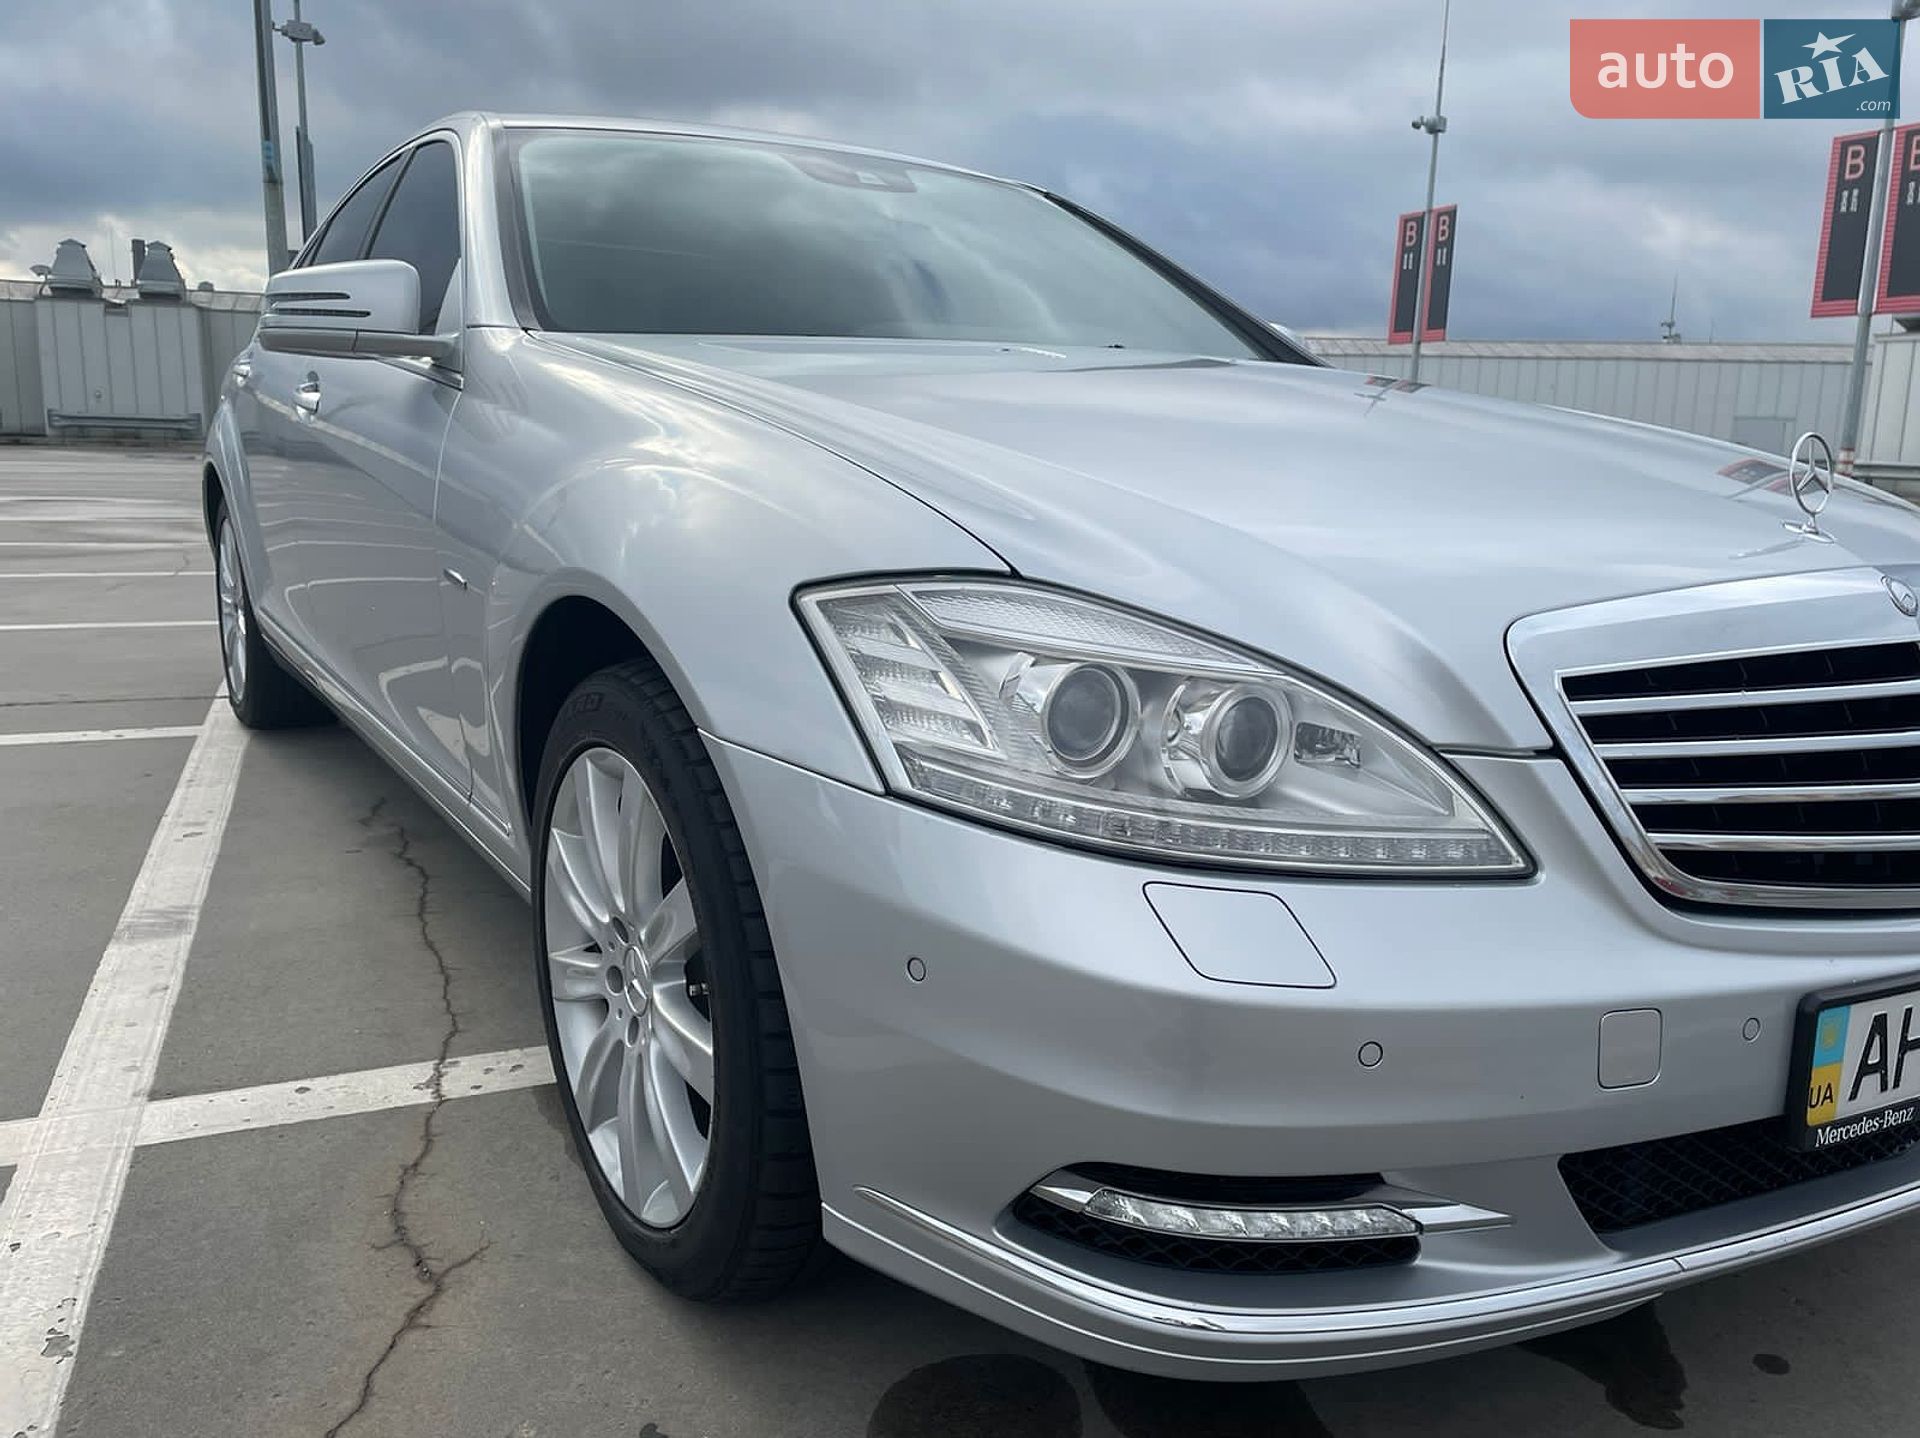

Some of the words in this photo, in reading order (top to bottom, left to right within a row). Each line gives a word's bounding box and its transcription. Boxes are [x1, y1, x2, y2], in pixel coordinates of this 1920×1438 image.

[1845, 144, 1865, 179] B
[1405, 221, 1417, 247] B
[1438, 215, 1449, 241] B
[1808, 1082, 1834, 1108] UA
[1815, 1106, 1914, 1147] Mercedes-Benz
